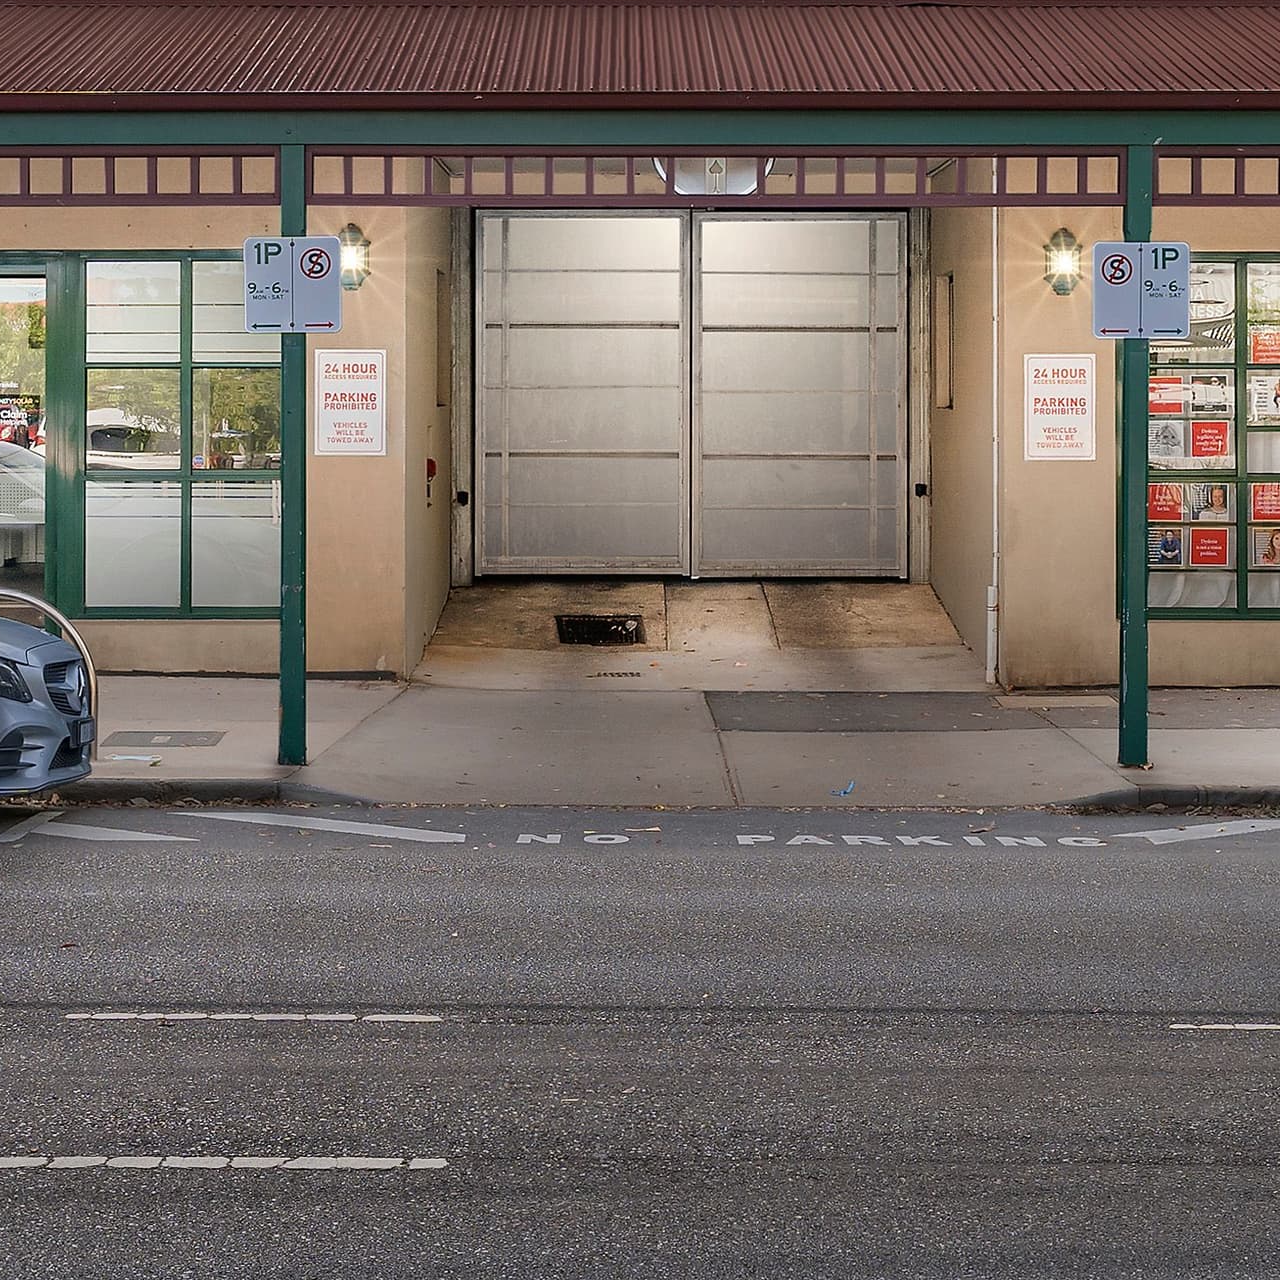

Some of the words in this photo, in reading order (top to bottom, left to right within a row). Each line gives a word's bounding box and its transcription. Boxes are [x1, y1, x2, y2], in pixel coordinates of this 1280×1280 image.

[254, 242, 282, 264] 1P
[1151, 248, 1179, 269] 1P
[324, 363, 339, 373] 24
[342, 363, 377, 373] HOUR
[1033, 368, 1048, 378] 24
[1051, 368, 1086, 378] HOUR
[324, 392, 377, 402] PARKING
[1033, 397, 1086, 407] PARKING
[516, 834, 631, 844] NO
[735, 834, 1108, 847] PARKING
